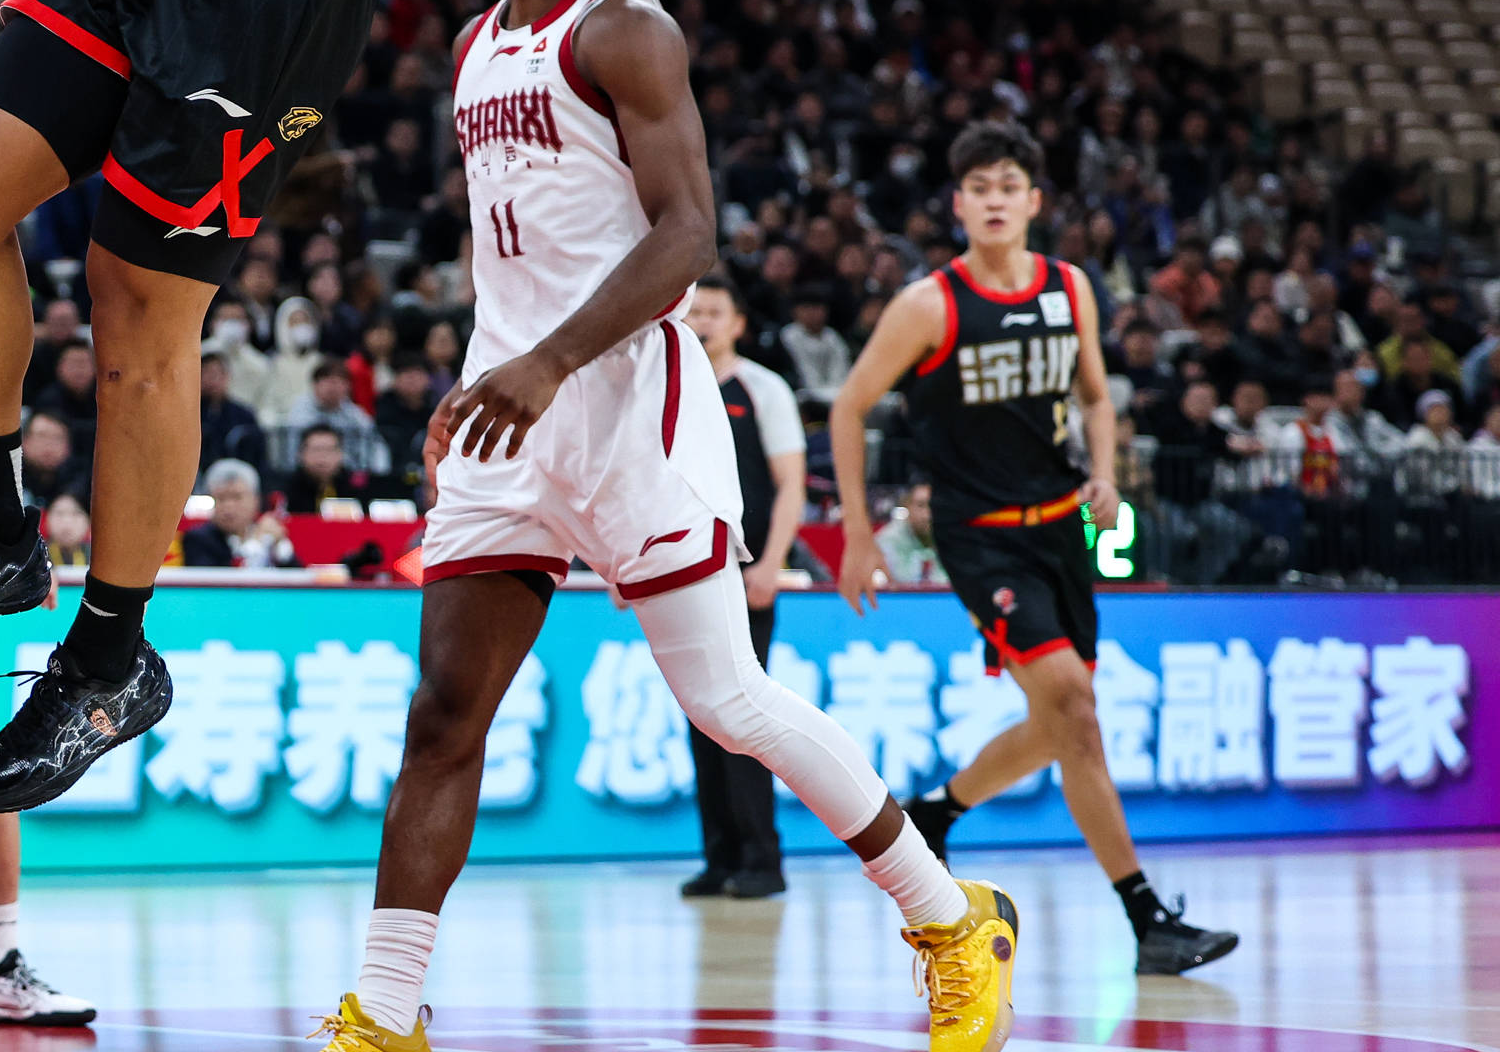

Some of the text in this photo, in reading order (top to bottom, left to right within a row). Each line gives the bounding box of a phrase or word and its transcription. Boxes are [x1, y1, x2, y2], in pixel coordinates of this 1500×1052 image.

[454, 84, 564, 161] SHANXI
[490, 197, 525, 258] 11
[957, 334, 1079, 405] 深圳
